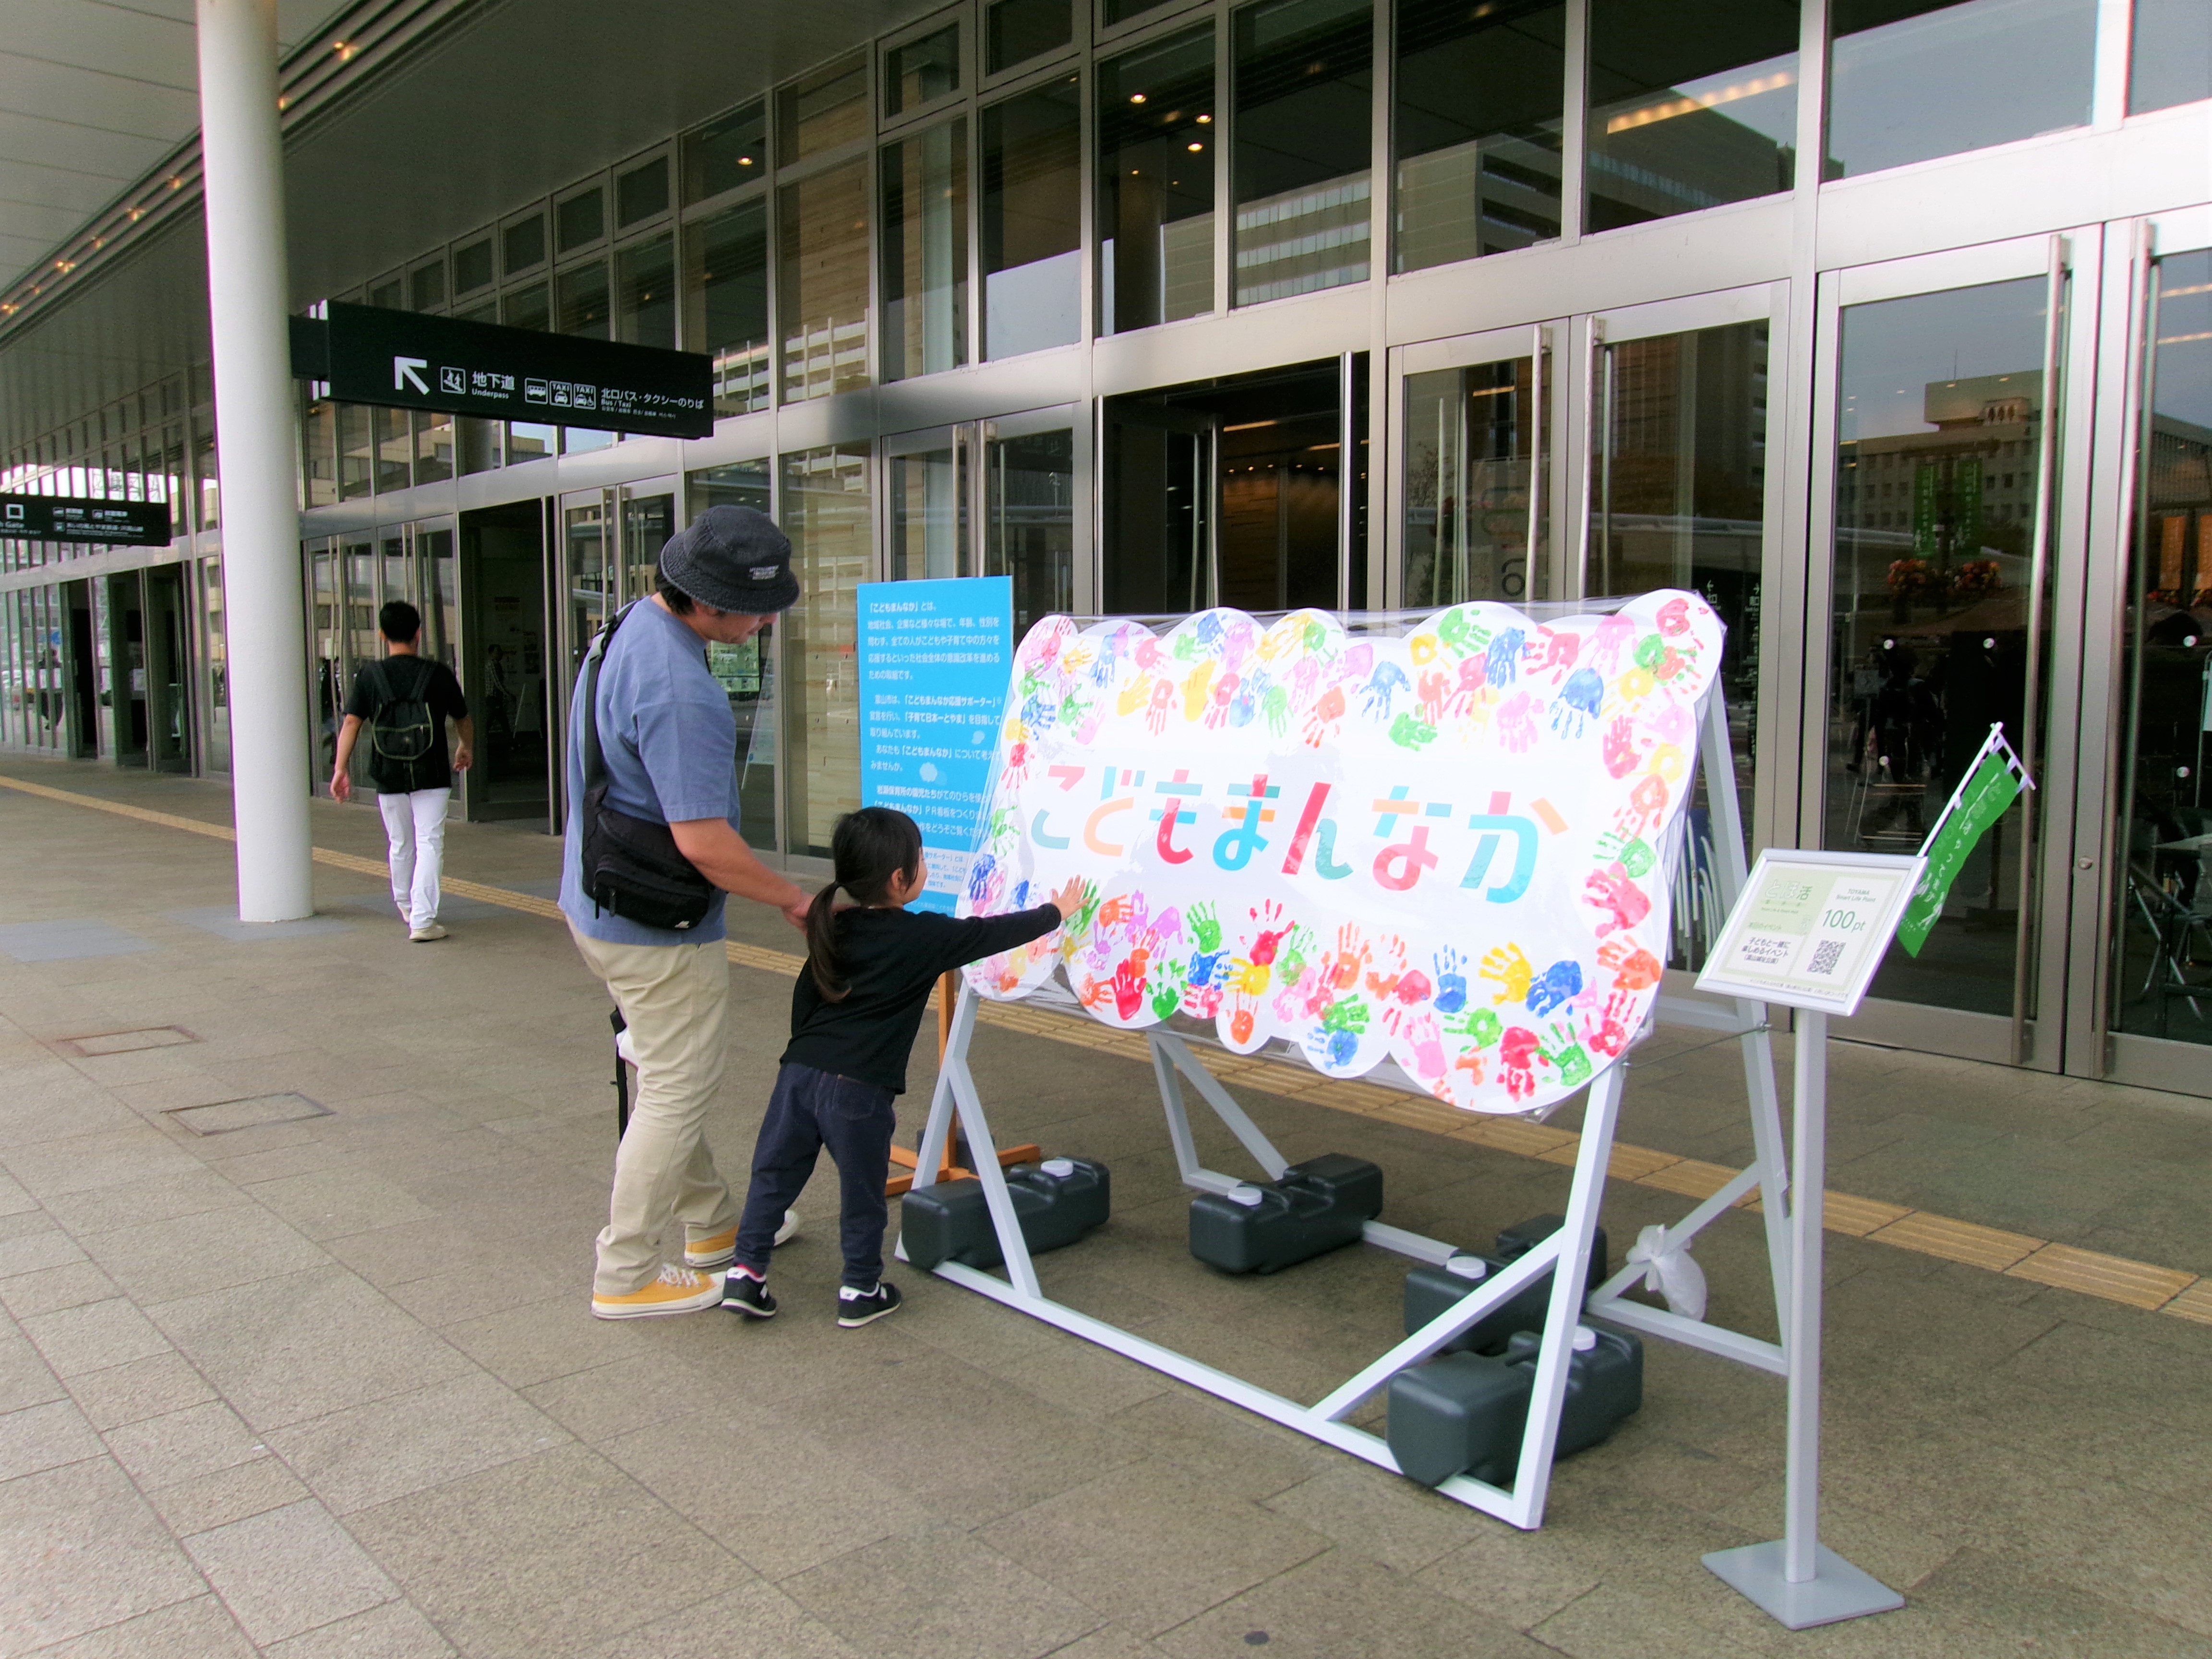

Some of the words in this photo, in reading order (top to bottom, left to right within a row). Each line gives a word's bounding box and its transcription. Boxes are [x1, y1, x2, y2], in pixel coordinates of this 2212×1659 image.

[472, 371, 516, 391] 地下道
[471, 387, 510, 399] Underpass
[601, 387, 704, 409] 北口バス・タクシーのりば
[1031, 765, 1569, 903] こどもまんなか
